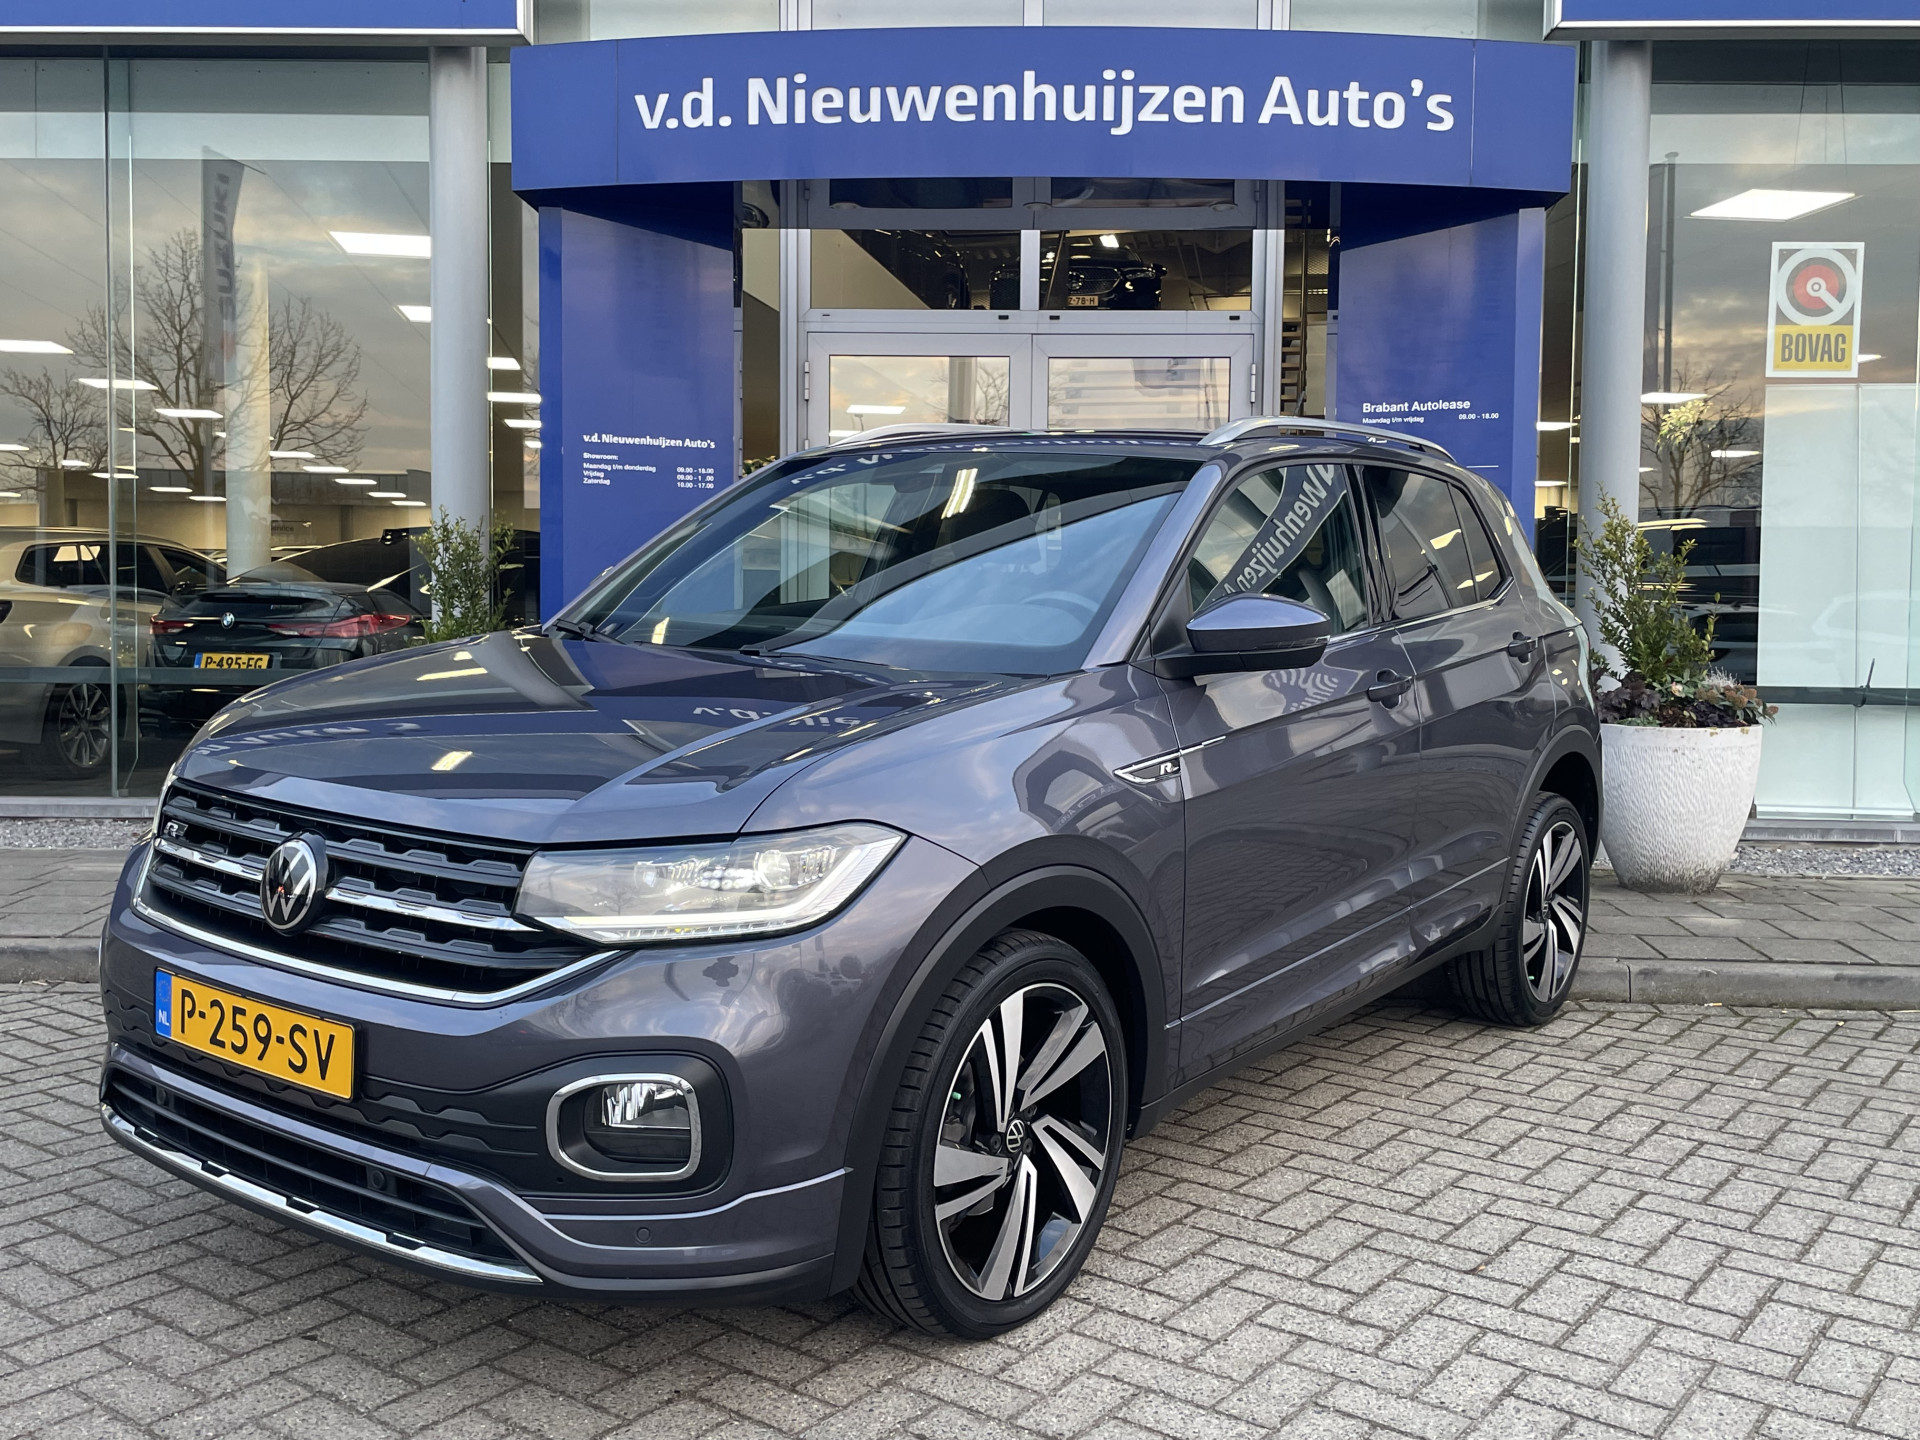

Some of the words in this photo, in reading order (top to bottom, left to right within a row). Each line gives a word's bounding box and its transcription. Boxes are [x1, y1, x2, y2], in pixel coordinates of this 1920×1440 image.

[635, 77, 732, 129] v.d.
[748, 70, 1244, 135] Nieuwenhuijzen
[1257, 76, 1455, 132] Auto's
[1781, 333, 1846, 363] BOVAG
[1363, 402, 1409, 413] Brabant
[1412, 400, 1470, 411] Autolease
[583, 433, 601, 443] v.d.
[602, 434, 682, 448] Nieuwenhuijzen
[684, 438, 715, 448] Auto's
[583, 452, 618, 460] Showroom:
[583, 463, 611, 471] Maandag
[624, 464, 656, 473] donderdag
[159, 1009, 170, 1026] NL
[181, 988, 336, 1081] P-259-SV
